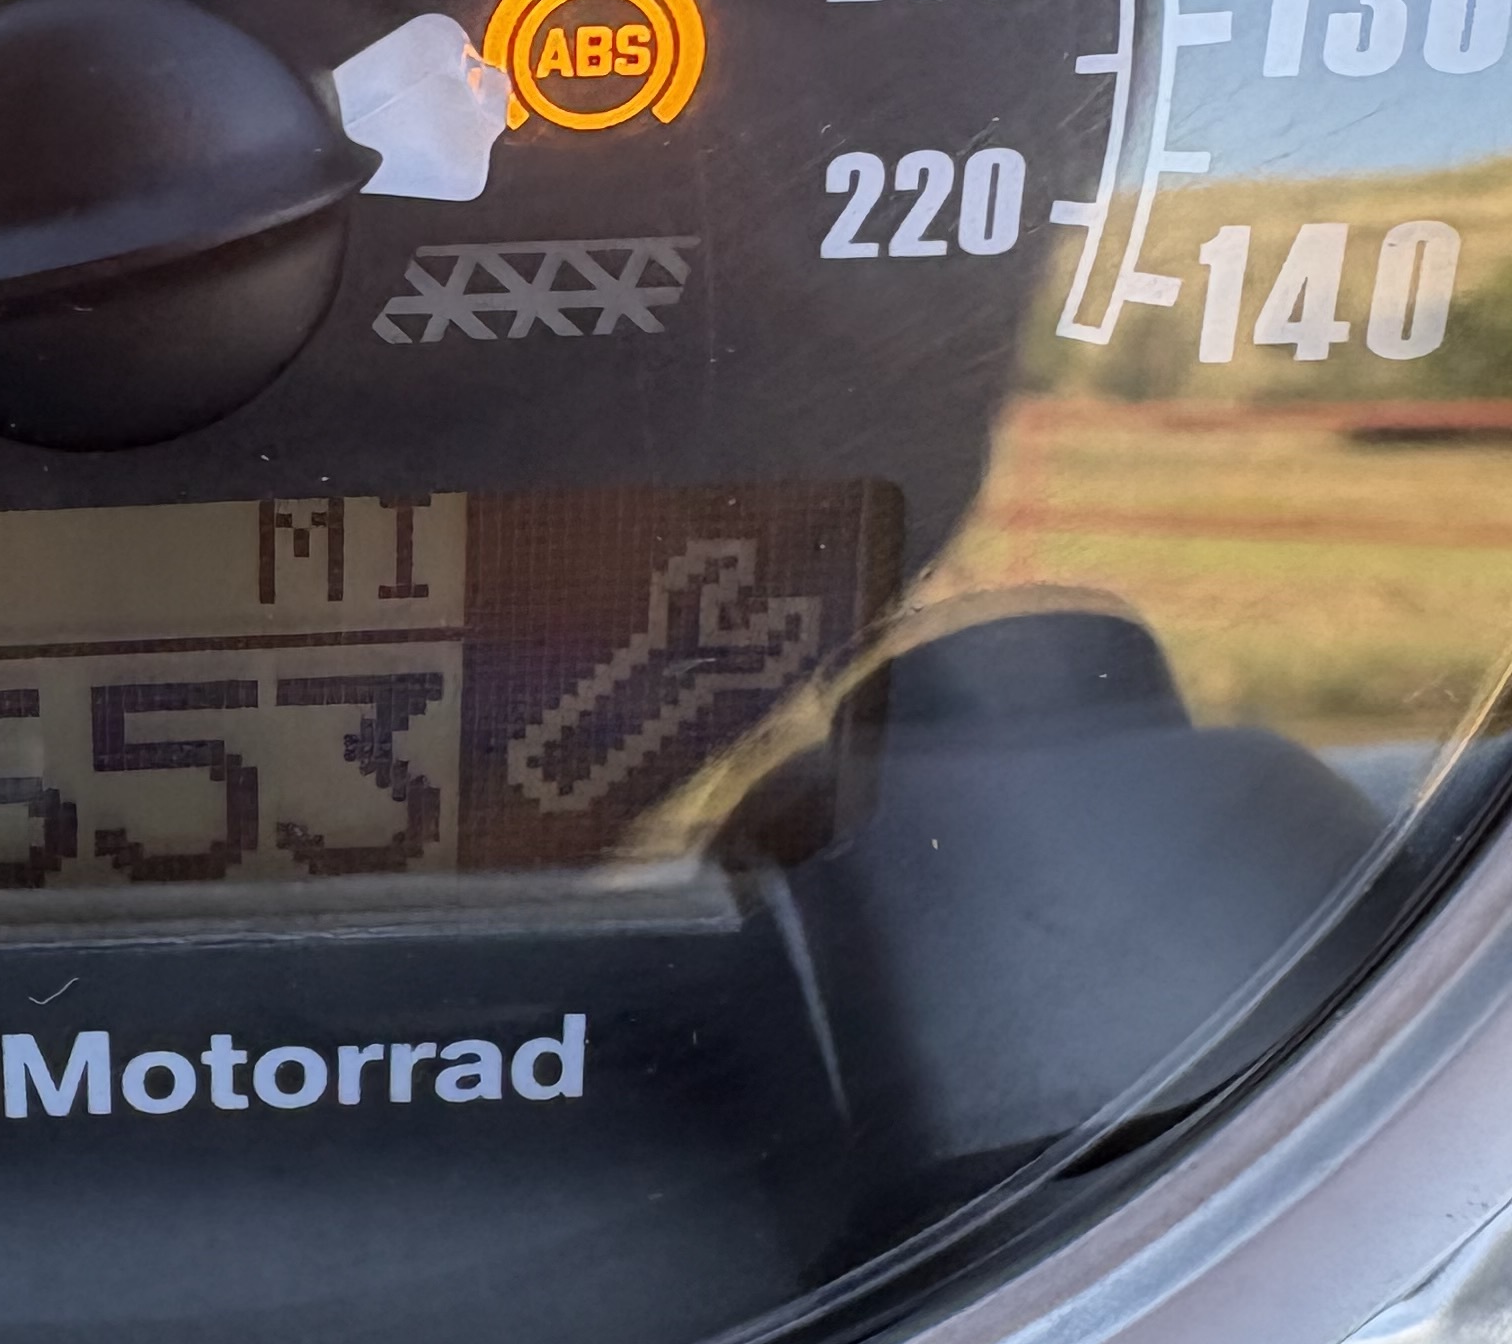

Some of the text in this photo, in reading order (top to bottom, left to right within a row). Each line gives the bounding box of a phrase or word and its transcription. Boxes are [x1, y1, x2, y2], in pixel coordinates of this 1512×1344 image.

[536, 25, 651, 78] ABS
[820, 148, 1026, 258] 220
[1197, 221, 1461, 363] 140
[259, 496, 431, 604] MI
[2, 1013, 589, 1121] Motorrad
